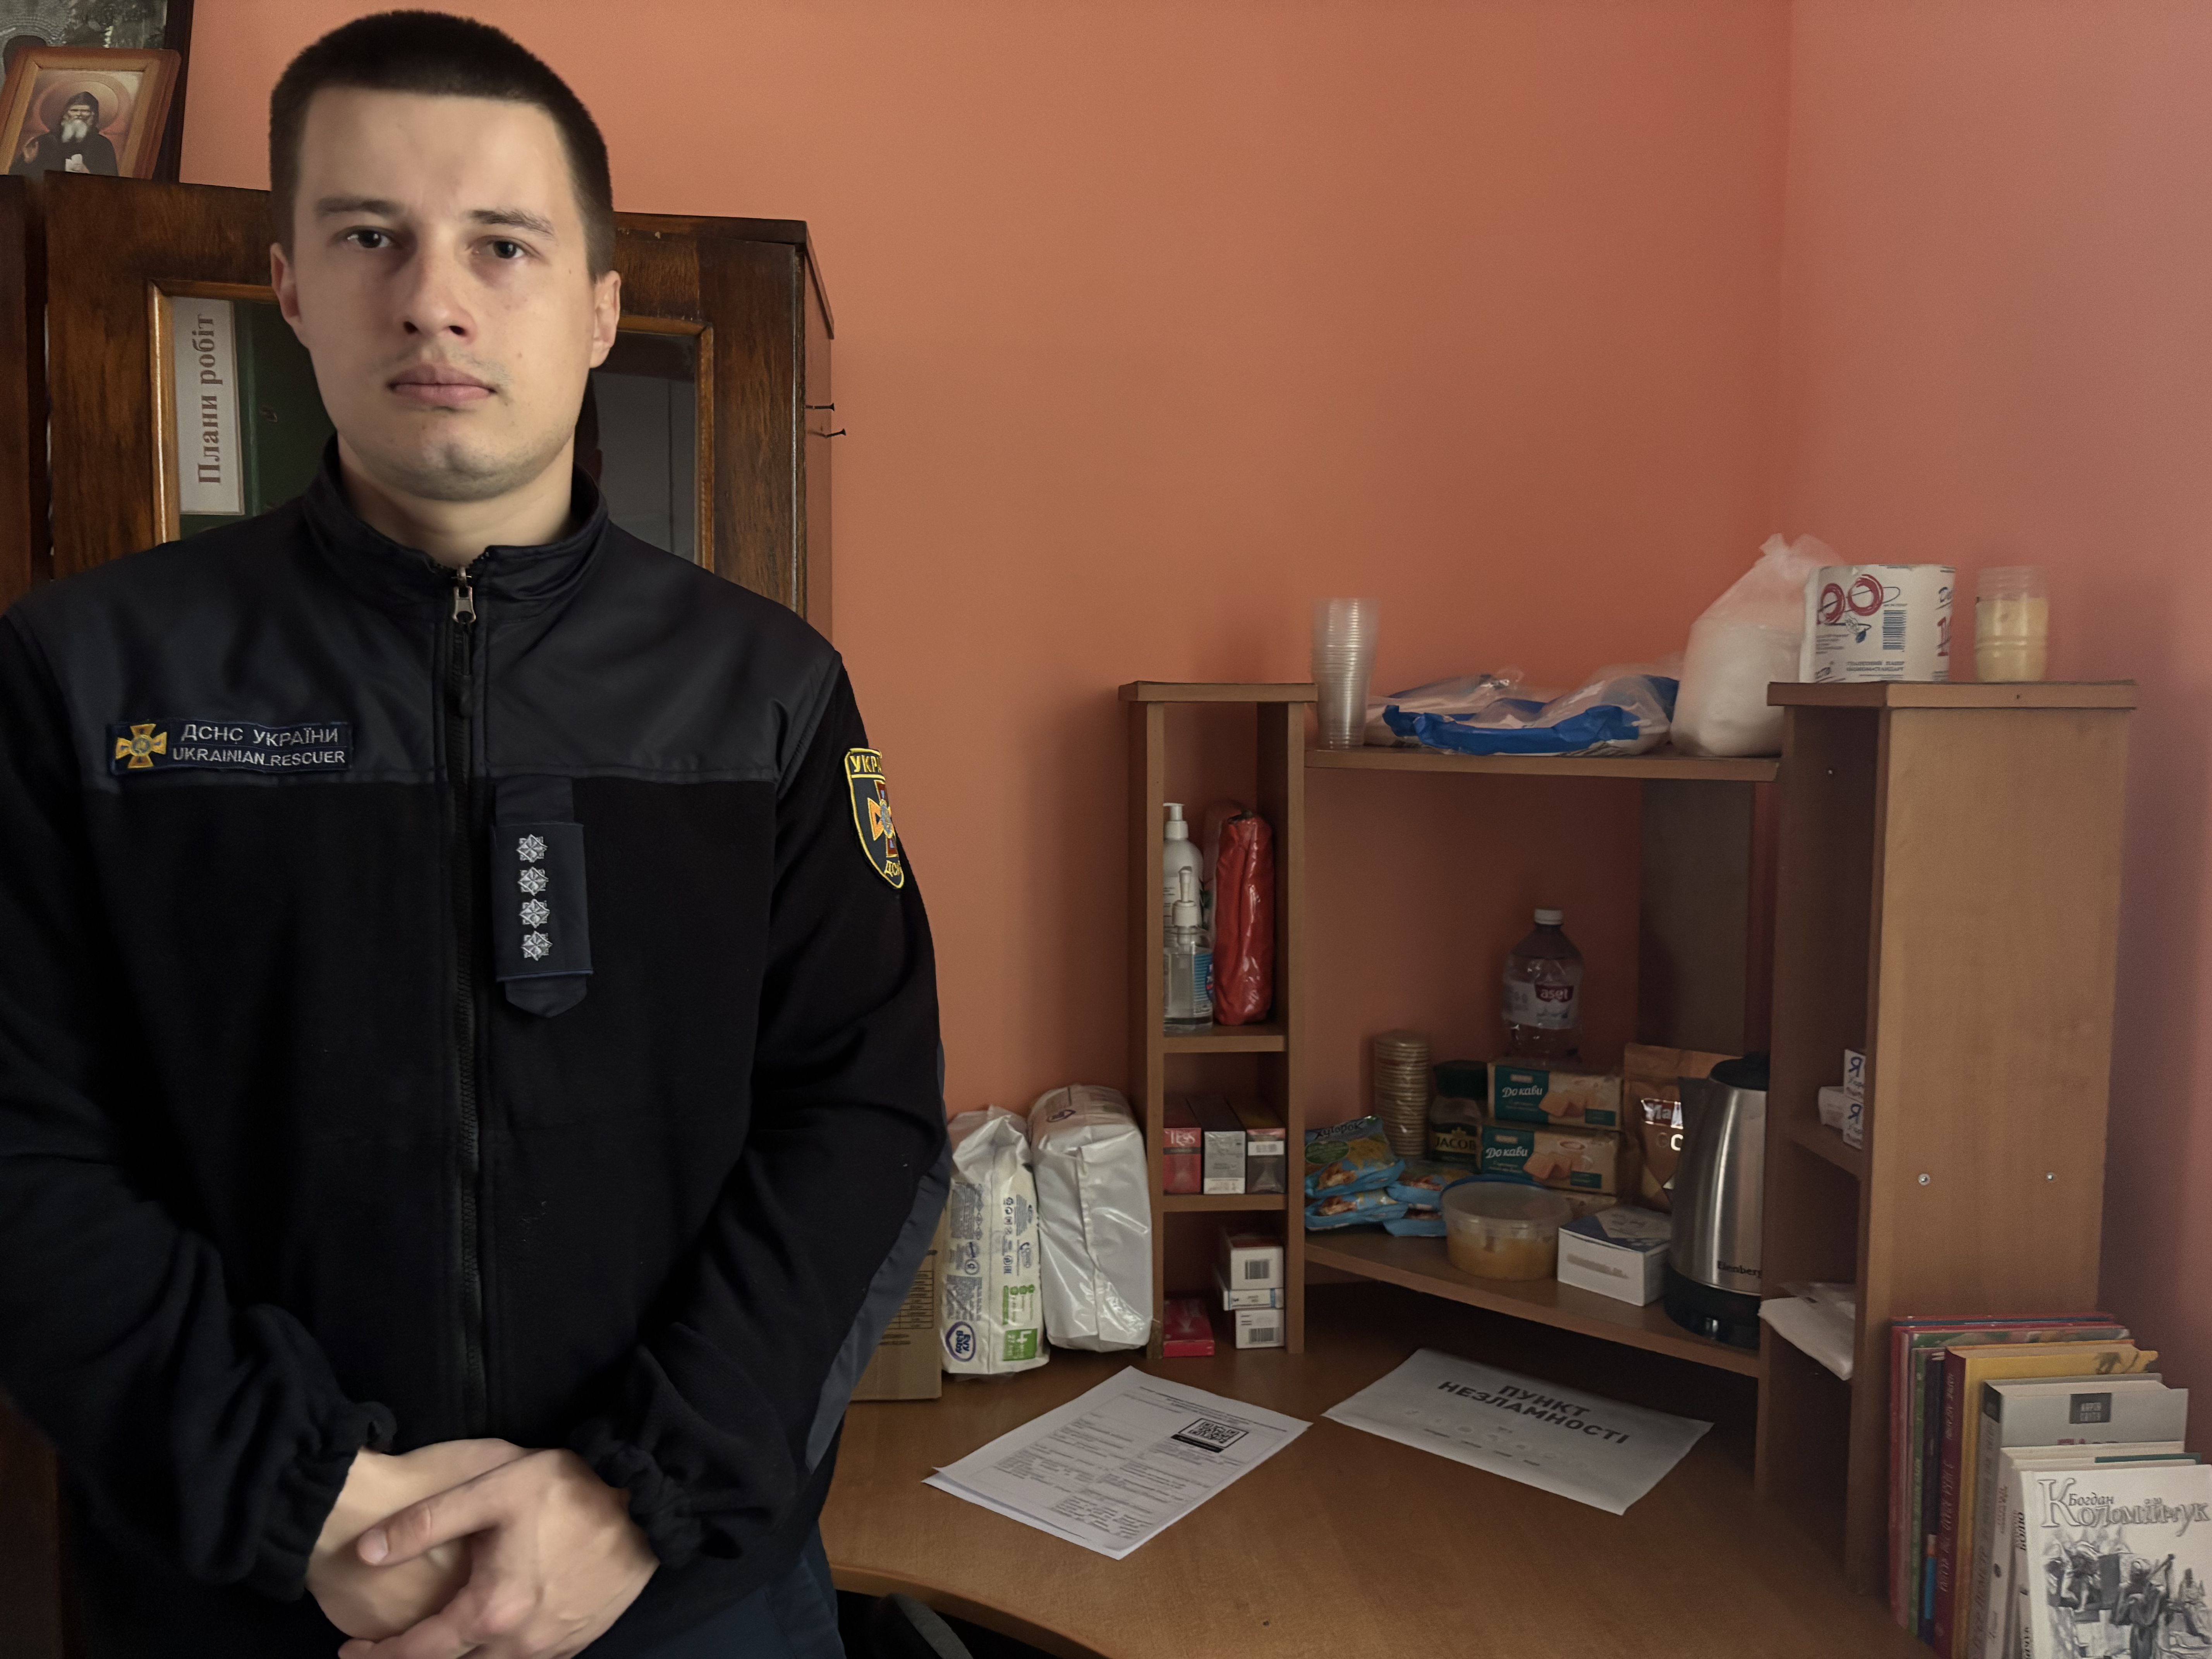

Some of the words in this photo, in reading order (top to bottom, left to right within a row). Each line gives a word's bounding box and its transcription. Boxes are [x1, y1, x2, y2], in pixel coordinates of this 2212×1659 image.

[192, 314, 223, 386] робіт
[198, 394, 221, 484] Плани
[181, 724, 243, 744] ДСНС
[252, 727, 338, 747] УКРАЇНИ
[172, 747, 267, 765] UKRAINIAN
[269, 750, 345, 767] RESCUER
[1502, 1087, 1518, 1097] До
[1518, 1085, 1543, 1096] кави
[1165, 1130, 1195, 1146] TESS
[1486, 1147, 1502, 1159] До
[1503, 1146, 1528, 1157] кави
[955, 1330, 964, 1354] Baby
[1498, 1385, 1590, 1416] ПУНКТ
[1437, 1381, 1630, 1444] НЕЗЛАМНОСТІ
[2069, 1492, 2114, 1506] Богдан
